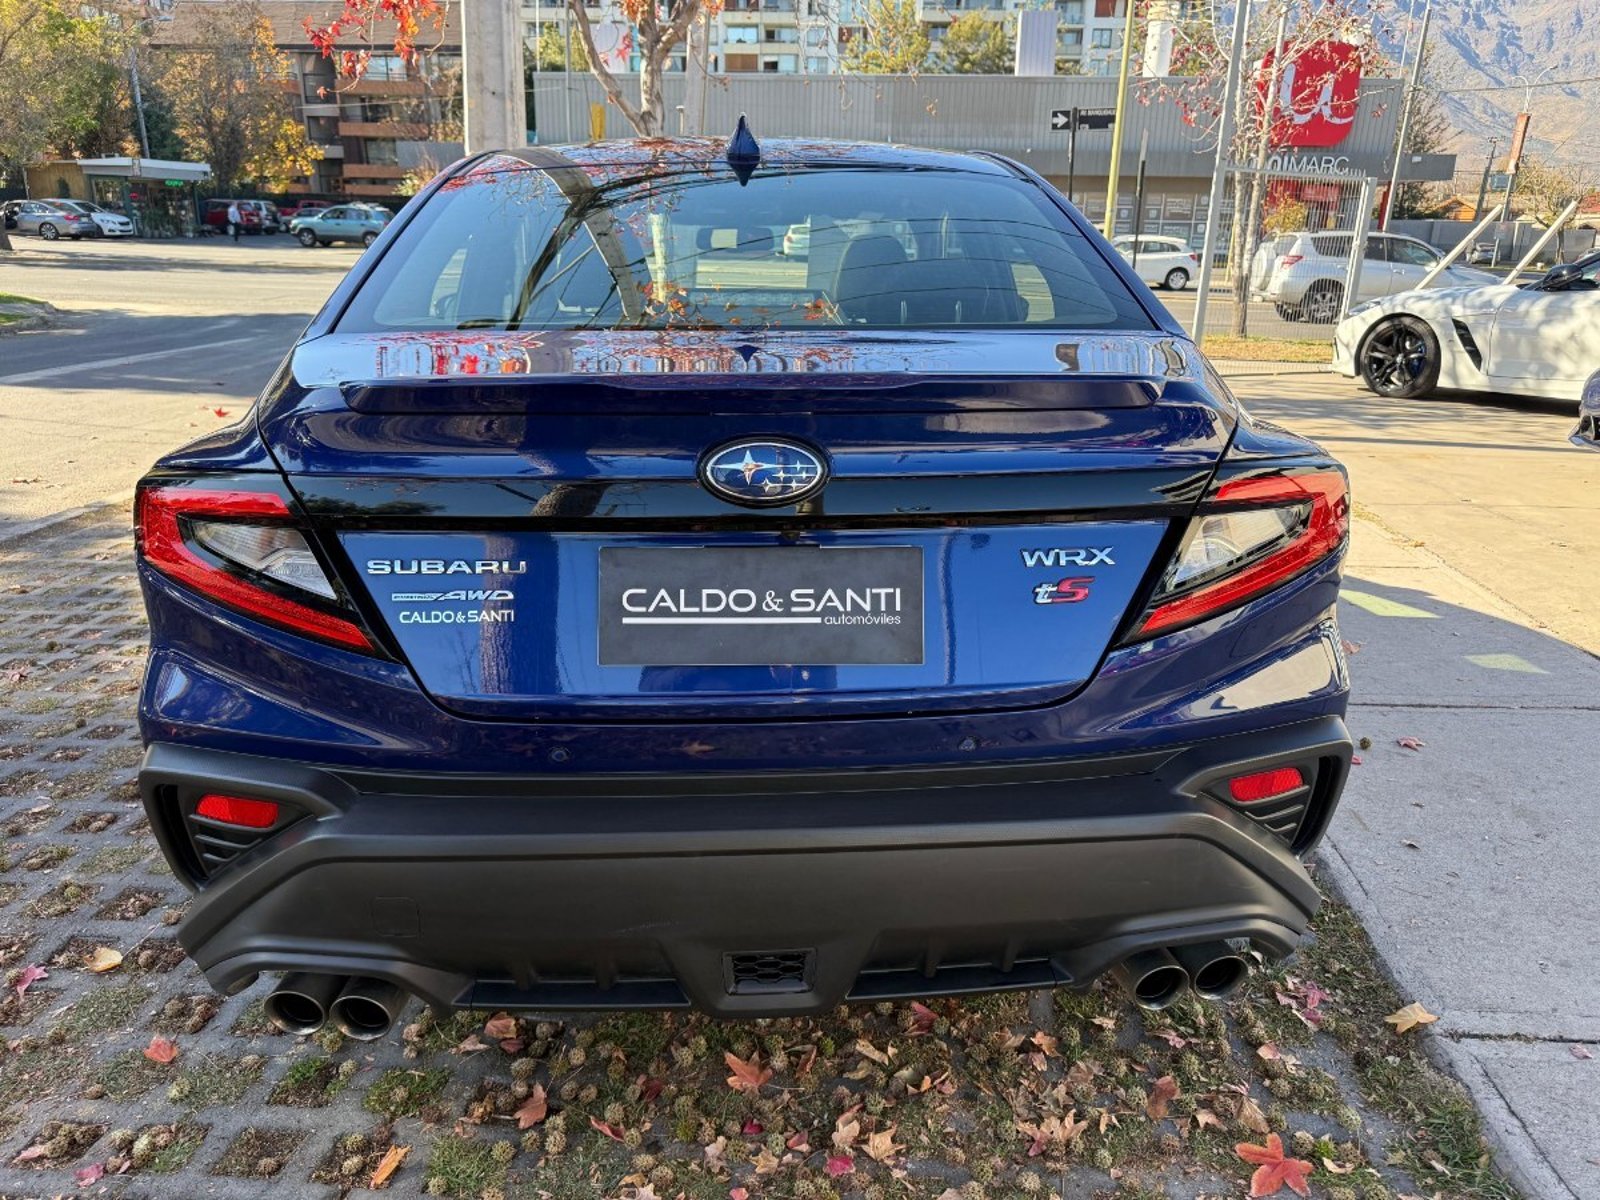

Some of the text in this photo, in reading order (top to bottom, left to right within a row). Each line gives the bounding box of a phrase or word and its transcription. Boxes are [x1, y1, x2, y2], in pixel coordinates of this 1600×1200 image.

[1021, 546, 1116, 567] WRX
[366, 559, 528, 575] SUBARU
[438, 589, 515, 601] AWD
[1034, 576, 1096, 604] tS
[823, 612, 901, 626] automóviles
